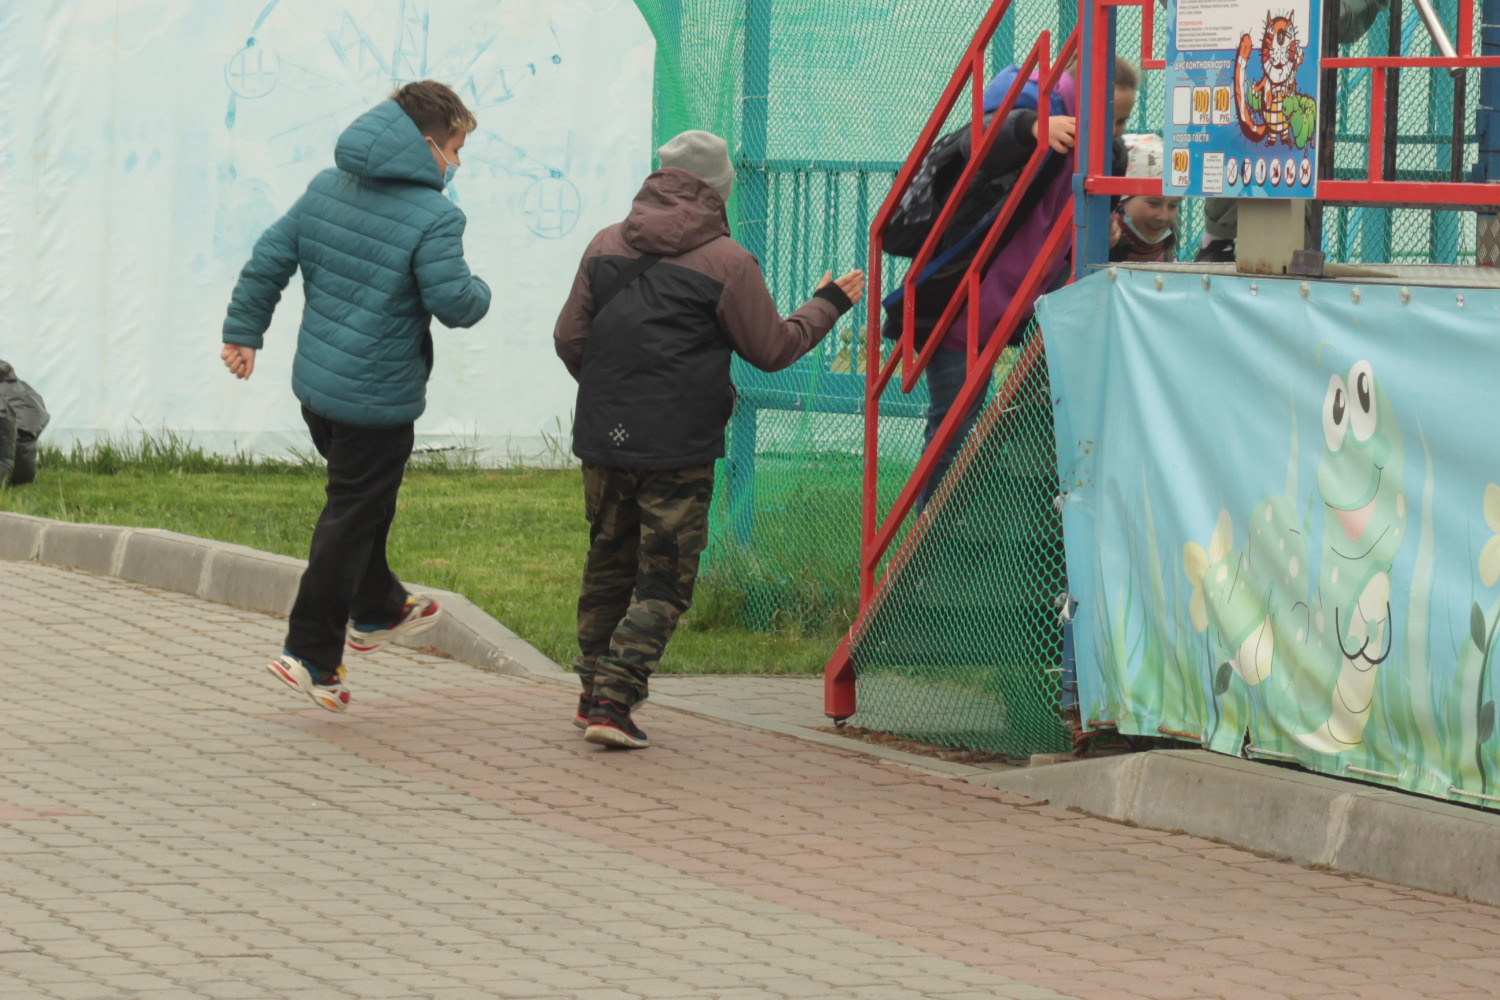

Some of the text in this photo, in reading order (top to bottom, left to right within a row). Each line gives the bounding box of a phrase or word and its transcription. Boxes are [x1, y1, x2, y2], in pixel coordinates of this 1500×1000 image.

[1193, 89, 1210, 114] 100
[1200, 113, 1210, 123] РУБ
[1219, 113, 1230, 123] РУБ
[1172, 151, 1189, 173] 130
[1178, 175, 1188, 185] РУБ
